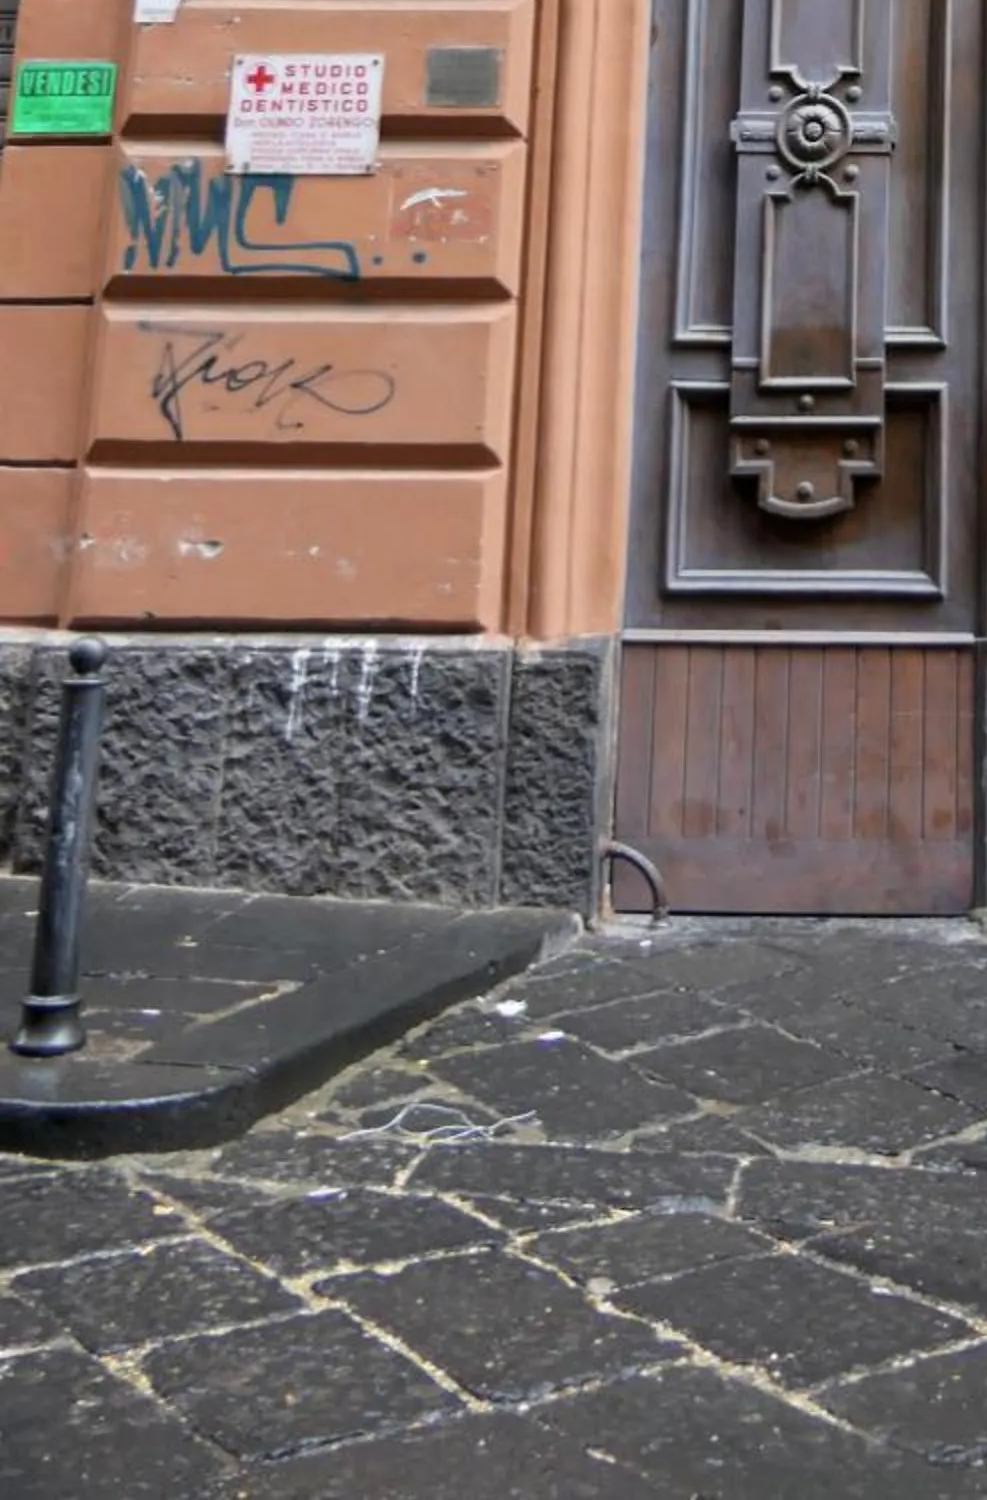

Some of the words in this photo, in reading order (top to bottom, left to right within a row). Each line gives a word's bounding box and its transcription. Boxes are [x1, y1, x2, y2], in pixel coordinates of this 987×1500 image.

[284, 64, 367, 78] STUDIO
[22, 69, 112, 96] VENDESI
[281, 82, 368, 96] MEDICO
[240, 99, 368, 113] DENTISTICO
